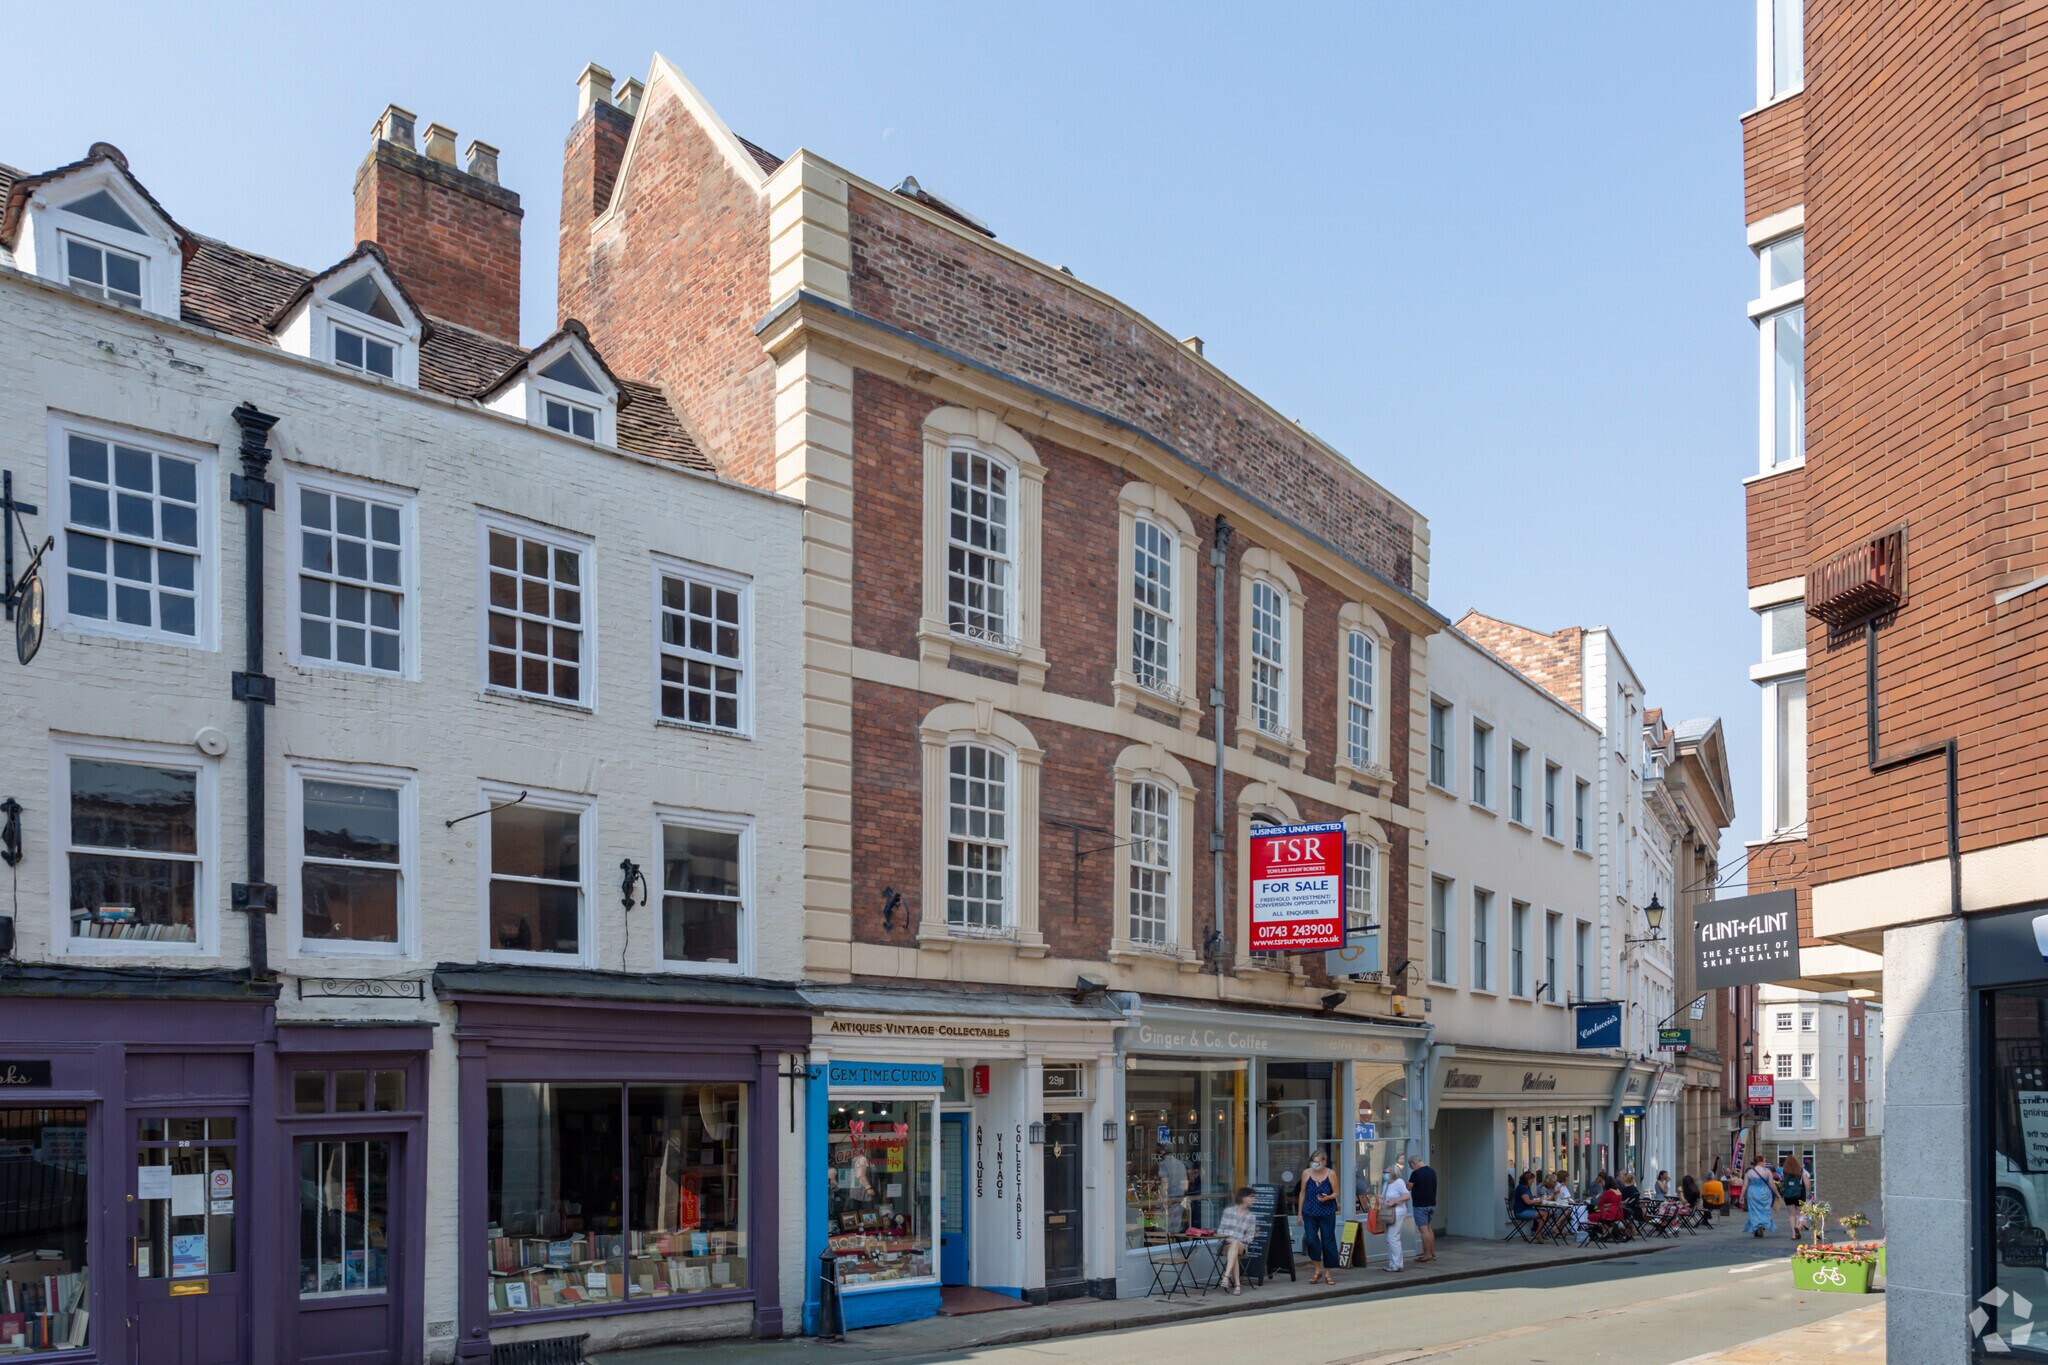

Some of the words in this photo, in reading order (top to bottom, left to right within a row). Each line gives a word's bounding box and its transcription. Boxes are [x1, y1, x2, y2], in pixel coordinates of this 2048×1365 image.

[1250, 826, 1287, 836] BUSINESS
[1289, 823, 1341, 833] UNAFFECTED
[1266, 837, 1325, 863] TSR
[1262, 883, 1290, 893] FOR
[1295, 880, 1329, 892] SALE
[1255, 901, 1292, 909] CONVERSION
[1258, 926, 1287, 938] 01743
[1292, 923, 1333, 936] 243900
[1702, 912, 1788, 942] FLINT+FLINT
[1253, 935, 1339, 947] www.tsrsurveyors.co.uk
[1703, 950, 1721, 958] THE
[1728, 943, 1768, 956] SECRET
[1703, 958, 1731, 968] SKIN
[1740, 950, 1789, 963] HEALTH
[1139, 1025, 1185, 1049] Ginger
[1190, 1031, 1198, 1047] &
[1204, 1030, 1223, 1048] Co.
[1228, 1031, 1268, 1050] Coffee
[830, 1068, 858, 1082] GEM
[860, 1068, 889, 1082] TIME
[892, 1070, 937, 1083] CURIOS
[849, 1134, 908, 1154] Vintage
[1189, 1132, 1199, 1144] OR
